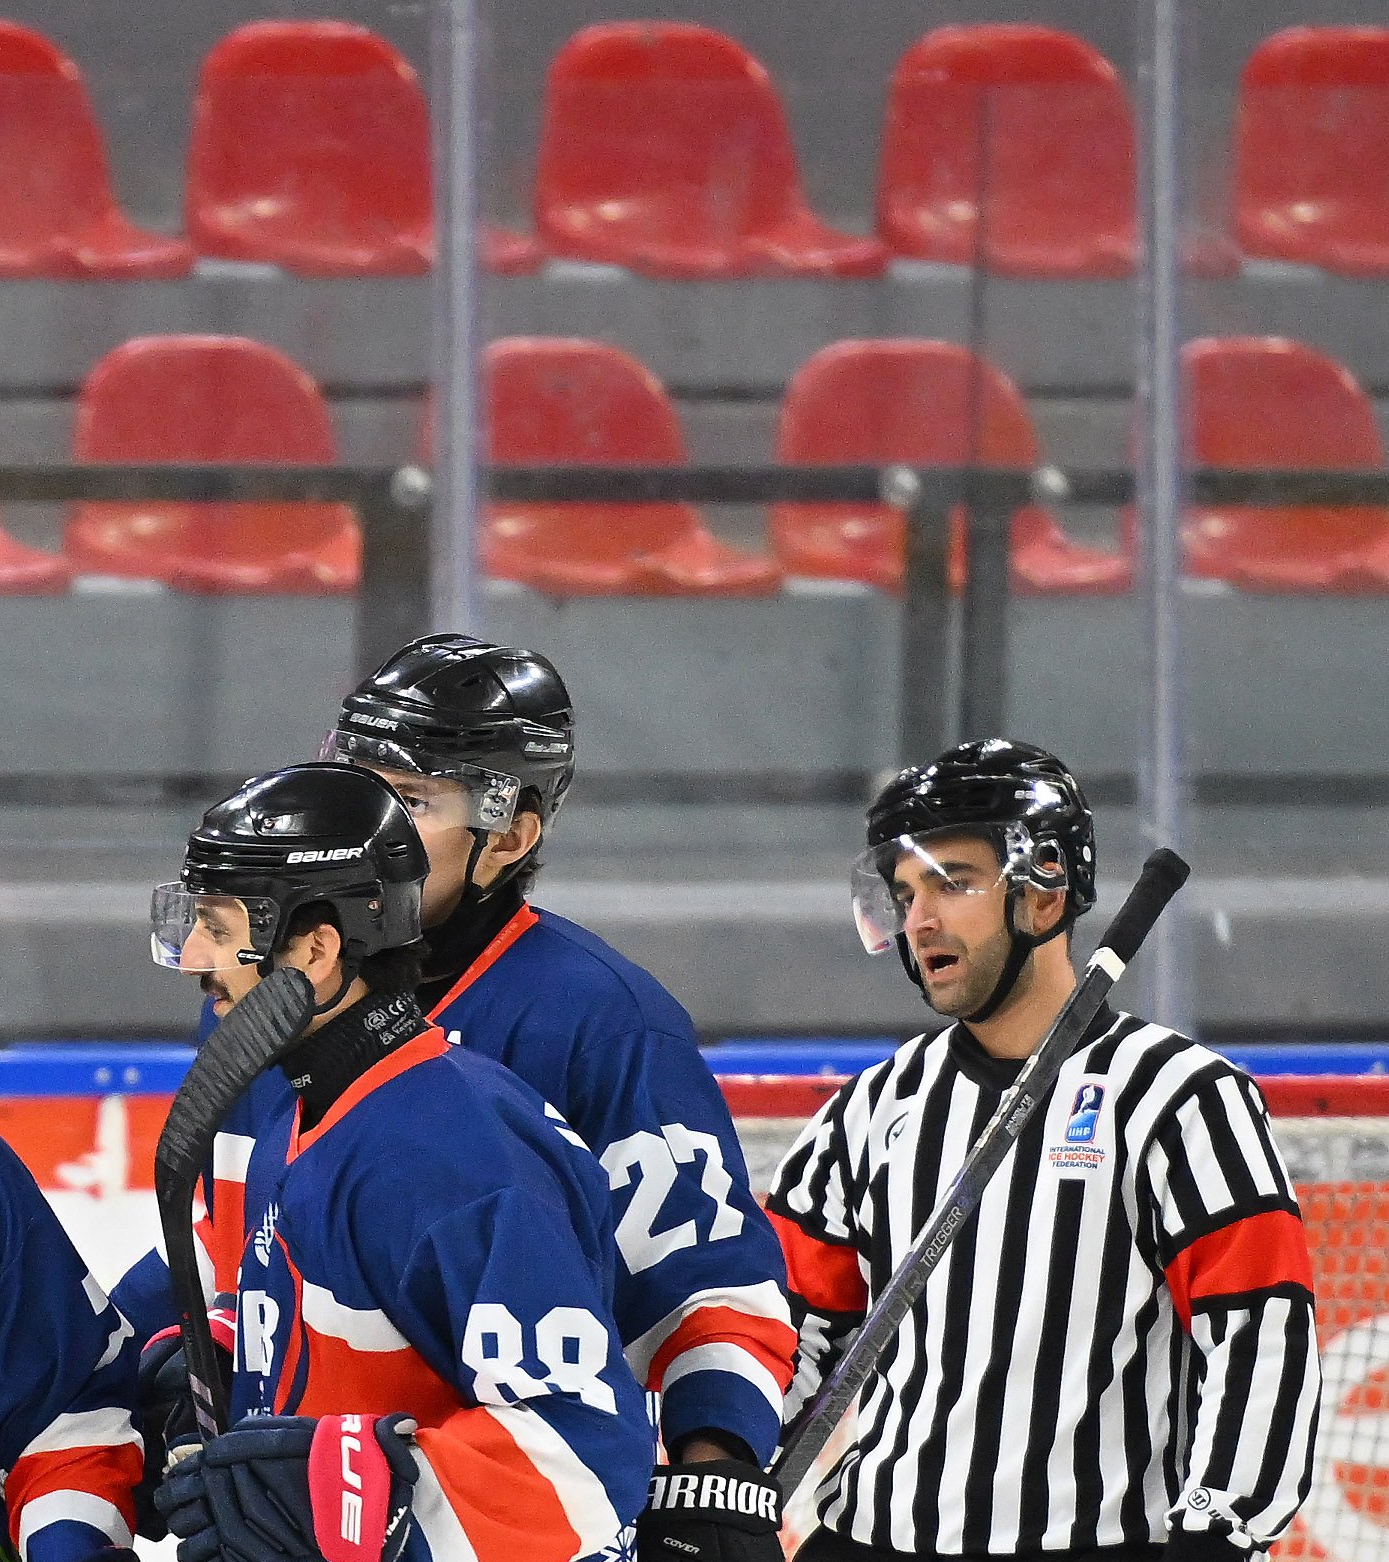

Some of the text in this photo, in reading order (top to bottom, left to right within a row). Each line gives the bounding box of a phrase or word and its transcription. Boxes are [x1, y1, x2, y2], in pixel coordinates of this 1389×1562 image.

[286, 847, 364, 864] BAUER
[1049, 1145, 1106, 1155] INTERNATIONAL
[1052, 1160, 1099, 1170] FEDERATION
[1064, 1152, 1106, 1163] HOCKEY
[599, 1122, 745, 1275] 27
[919, 1206, 964, 1268] TRIGGER
[461, 1303, 619, 1416] 88
[646, 1474, 778, 1523] ARRIOR
